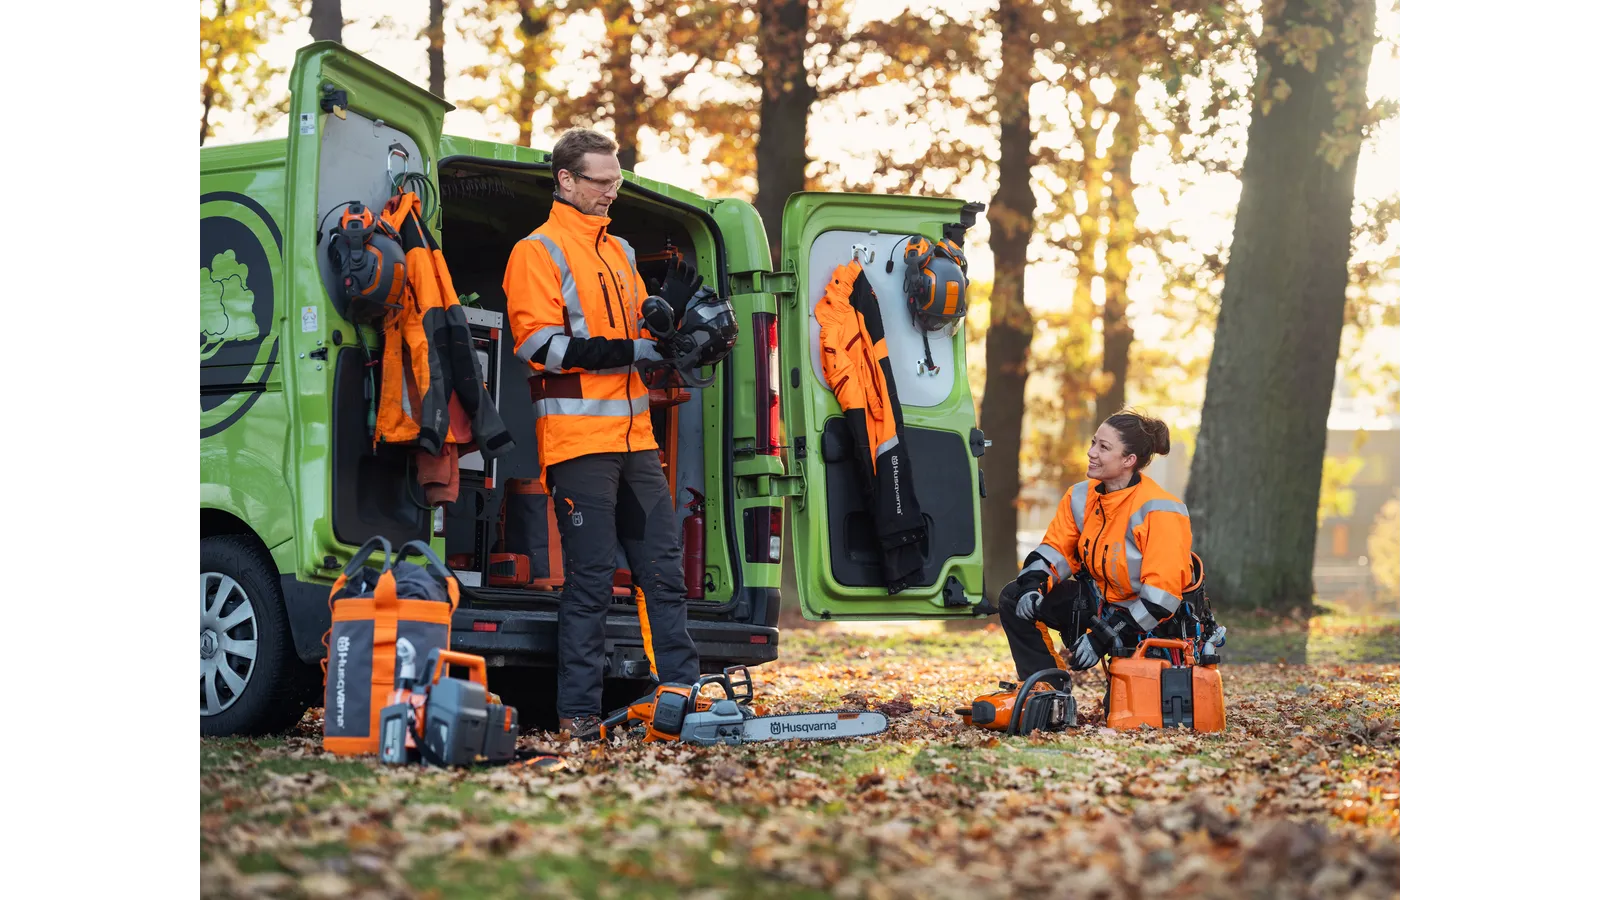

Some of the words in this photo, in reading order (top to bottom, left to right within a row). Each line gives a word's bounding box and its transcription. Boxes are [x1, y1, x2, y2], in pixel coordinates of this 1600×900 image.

[893, 465, 902, 514] Husqvarna
[336, 652, 348, 728] Husqvarna
[781, 722, 837, 733] Husqvarna
